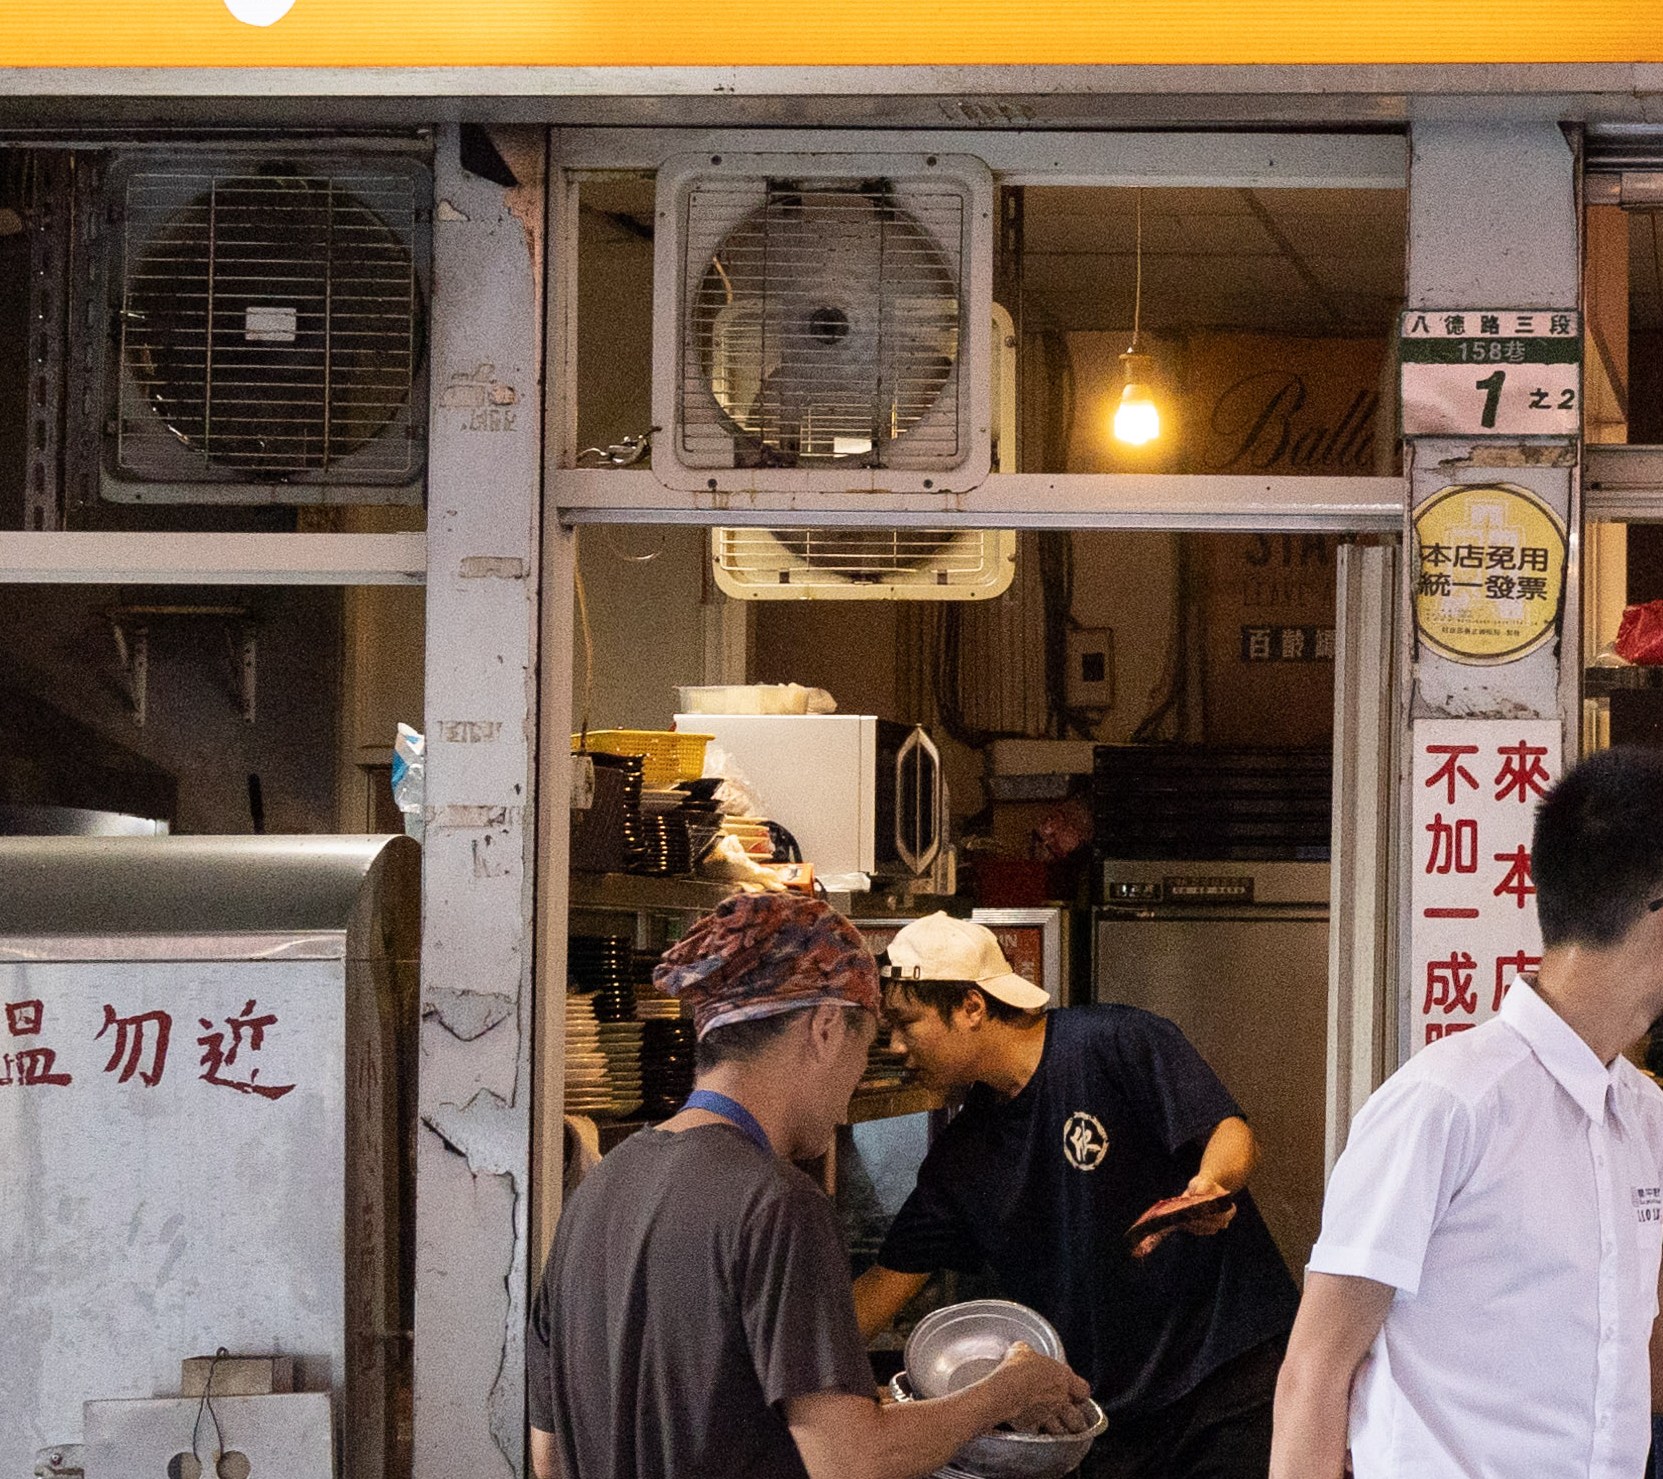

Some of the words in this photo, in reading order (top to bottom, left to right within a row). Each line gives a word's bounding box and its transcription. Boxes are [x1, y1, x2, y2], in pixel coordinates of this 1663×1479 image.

[1410, 312, 1573, 337] 八德路三段
[1456, 340, 1527, 362] 158巷
[1419, 542, 1549, 573] 本店免用
[1417, 571, 1549, 601] 統一發票
